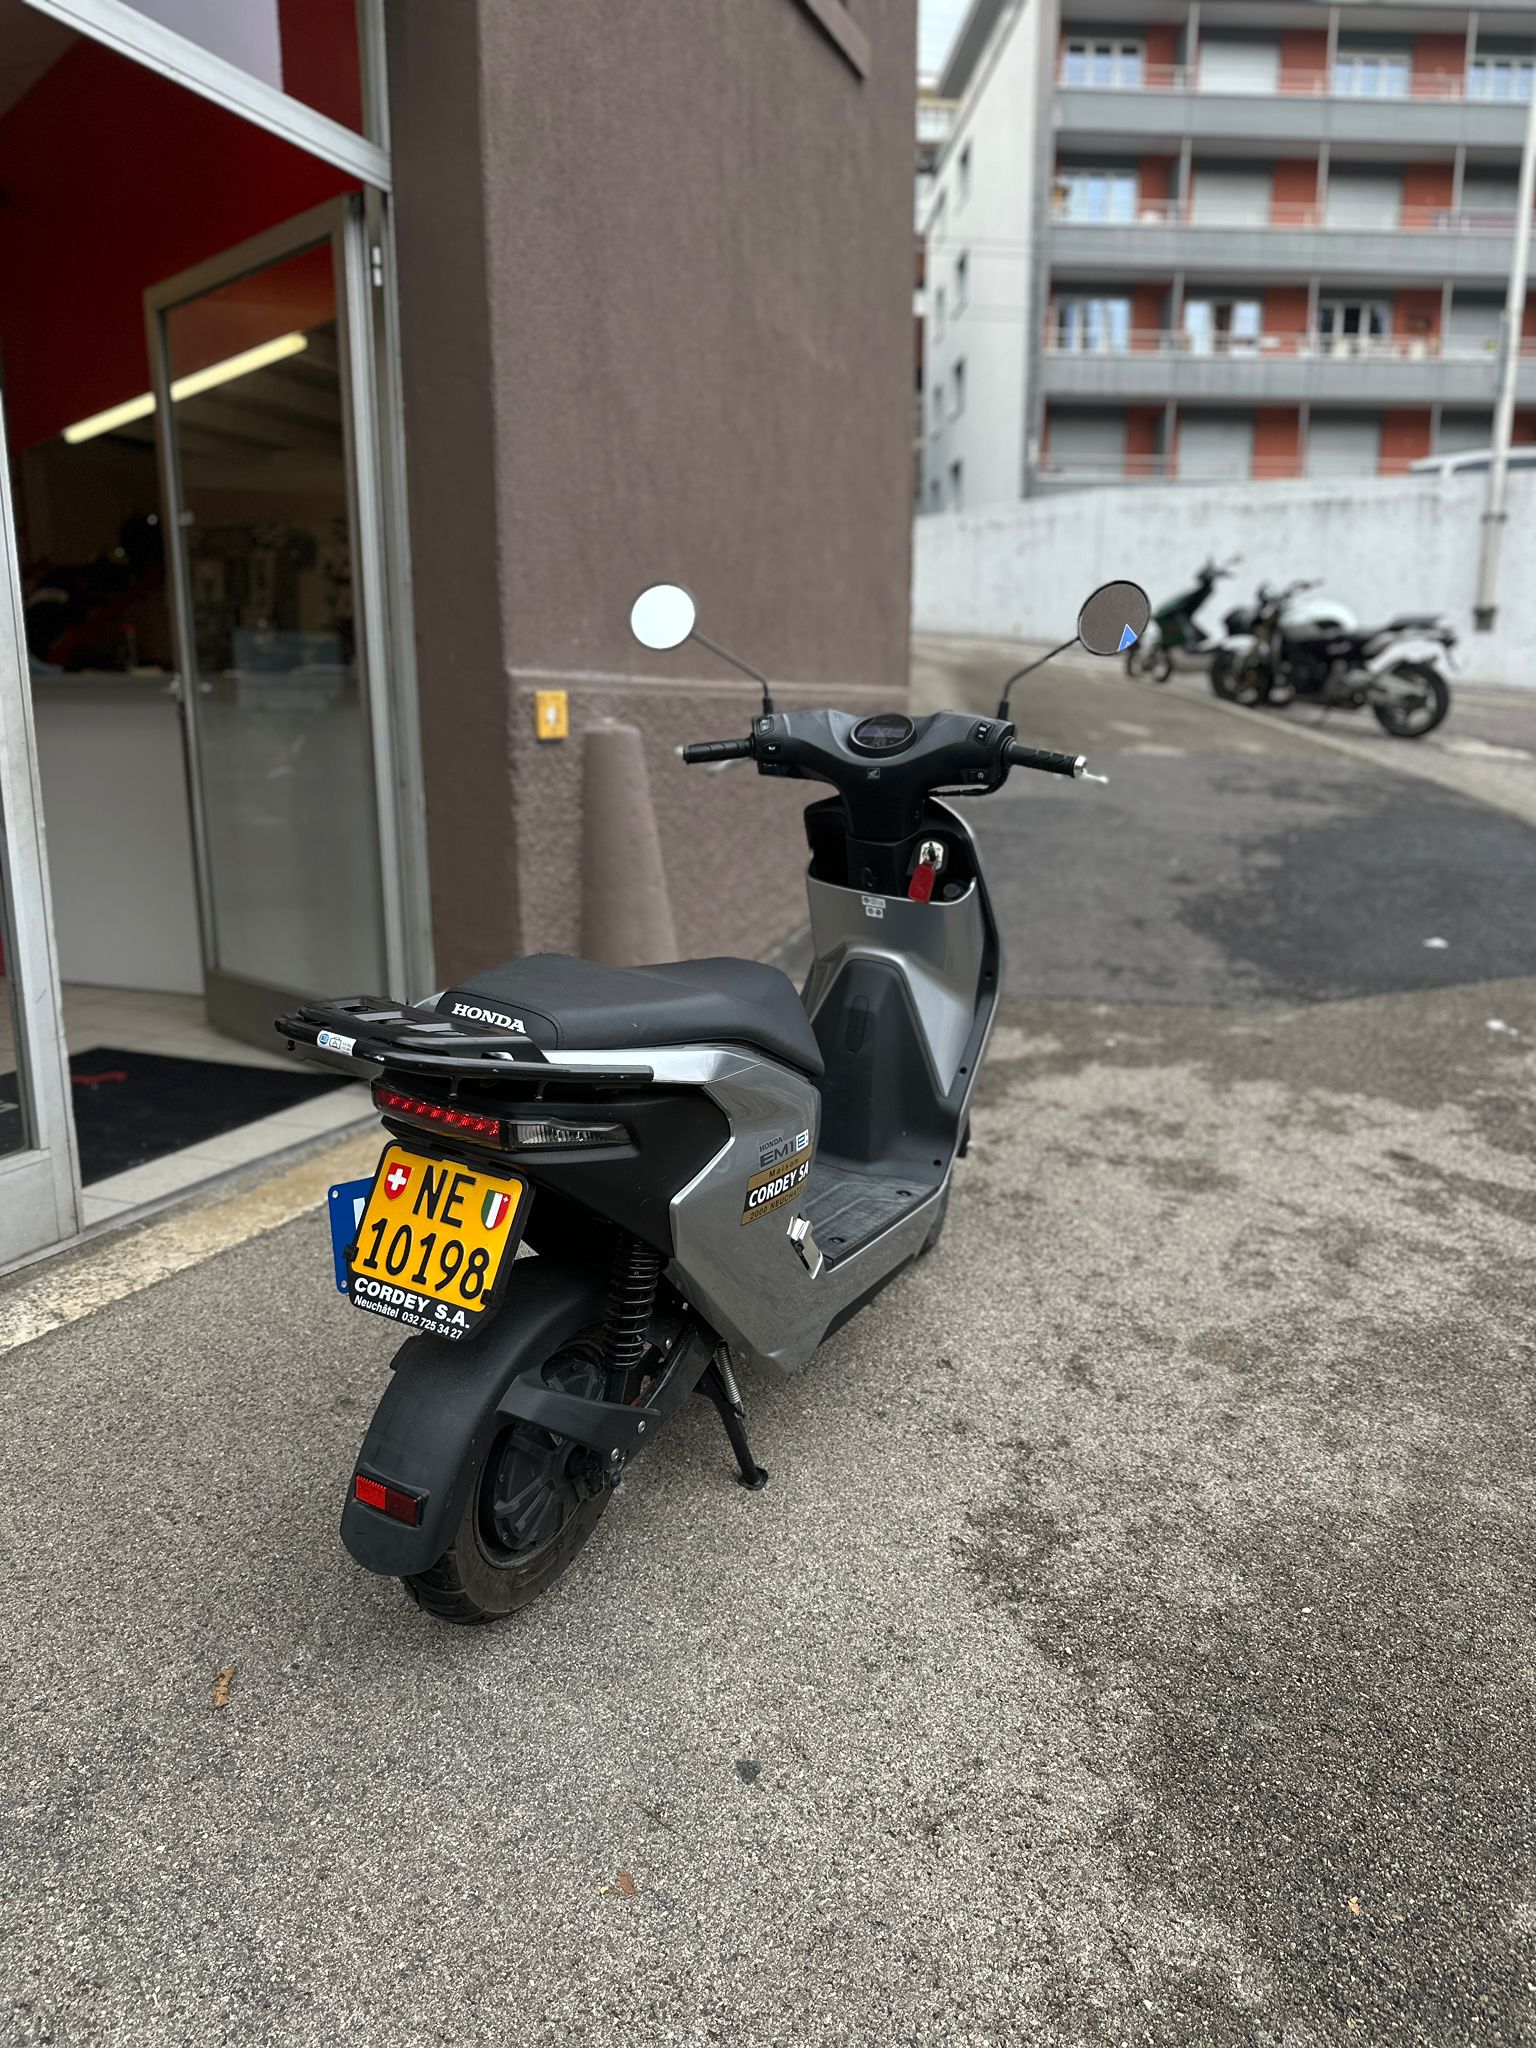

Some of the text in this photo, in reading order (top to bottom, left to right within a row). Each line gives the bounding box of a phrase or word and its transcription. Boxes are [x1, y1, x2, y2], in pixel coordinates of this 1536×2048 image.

[451, 1002, 527, 1034] HONDA
[759, 1136, 783, 1152] HONDA
[760, 1141, 794, 1168] EM1
[748, 1160, 809, 1207] CORDEY SA
[769, 1158, 799, 1179] Maison
[412, 1165, 477, 1229] NE
[750, 1206, 768, 1220] 2000
[363, 1217, 490, 1300] 10198
[353, 1294, 463, 1340] Neuchâtel 032 725 34 27
[354, 1277, 471, 1329] CORDEY S.A.
